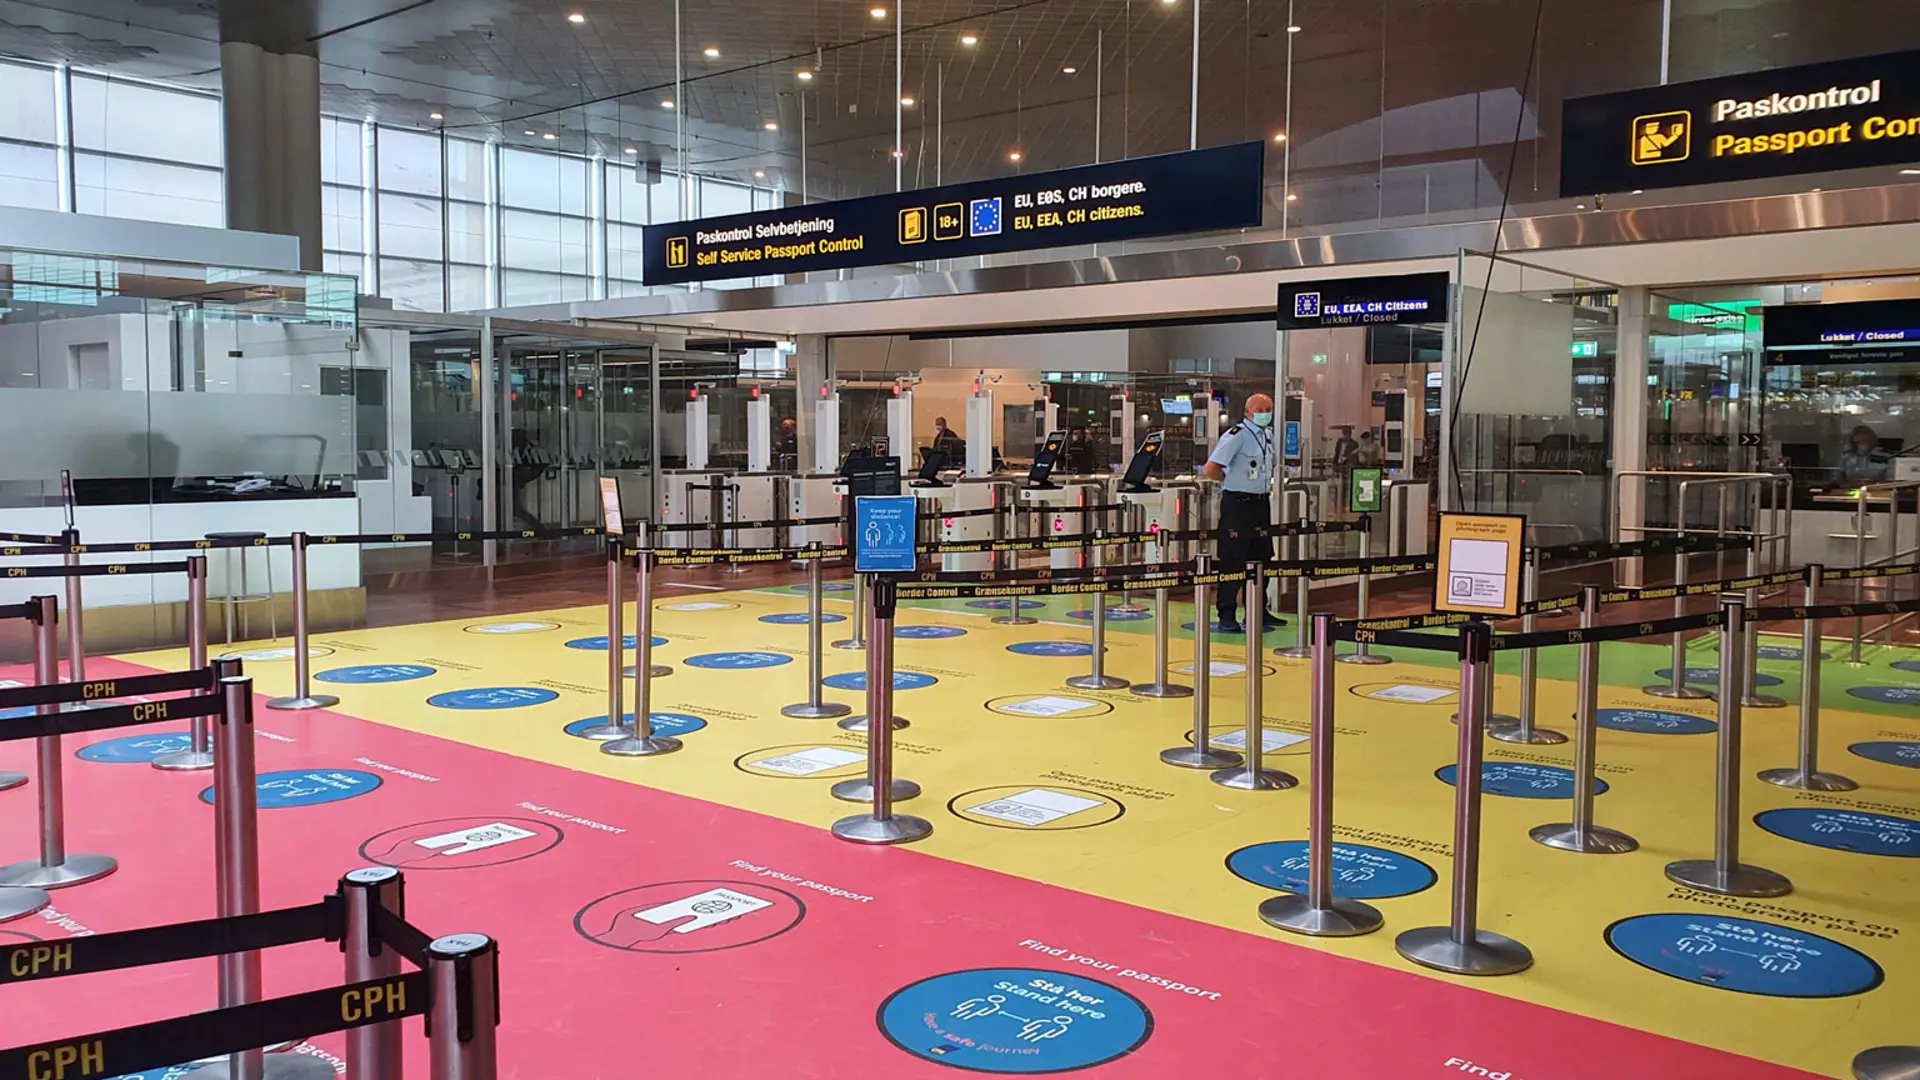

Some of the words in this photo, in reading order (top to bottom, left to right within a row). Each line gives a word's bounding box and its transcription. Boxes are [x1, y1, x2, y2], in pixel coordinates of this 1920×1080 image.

[1713, 79, 1881, 122] Paskontrol
[1714, 122, 1852, 157] Passport
[1014, 194, 1034, 209] EU,
[1037, 189, 1065, 206] EØS,
[1068, 187, 1087, 201] CH
[1091, 180, 1146, 199] borgere.
[939, 215, 959, 229] 18+
[1014, 217, 1034, 230] EU,
[1037, 213, 1064, 229] EEA,
[1067, 208, 1086, 224] CH
[1089, 204, 1144, 222] citizens.
[696, 226, 753, 245] Paskontrol
[756, 218, 835, 238] Selvbetjening
[696, 251, 718, 266] Self
[721, 249, 762, 264] Service
[764, 241, 816, 259] Passport
[818, 235, 863, 254] Control
[1320, 314, 1352, 325] Lukket
[1363, 312, 1398, 323] Closed
[1324, 305, 1341, 315] EU,
[1343, 303, 1365, 313] EEA,
[1367, 302, 1382, 312] CH
[1385, 300, 1428, 311] Citizens
[1820, 333, 1855, 342] Lukket
[1866, 331, 1904, 340] Closed
[1775, 352, 1784, 362] 4
[4, 548, 21, 556] CPH
[70, 545, 87, 553] CPH
[134, 543, 150, 551] CPH
[195, 540, 211, 549] CPH
[254, 538, 269, 546] CPH
[323, 535, 336, 543] CPH
[392, 533, 405, 541] CPH
[458, 532, 471, 540] CPH
[658, 556, 686, 564] Border
[686, 556, 714, 564] Control
[729, 553, 783, 562] Grænsekontrol
[797, 549, 822, 558] Border
[822, 548, 848, 557] Control
[1011, 542, 1032, 550] Control
[8, 568, 27, 577] CPH
[108, 565, 126, 574] CPH
[921, 573, 936, 581] CPH
[980, 572, 995, 580] CPH
[1038, 570, 1052, 578] CPH
[1093, 568, 1107, 576] CPH
[1146, 564, 1160, 573] CPH
[1264, 569, 1278, 577] rder
[1278, 568, 1302, 577] Control
[1314, 566, 1359, 575] Grænsekontrol
[1371, 565, 1391, 573] Border
[1392, 563, 1414, 572] Control
[896, 588, 926, 598] Border
[927, 586, 958, 597] Control
[974, 586, 1036, 596] Grænsekontrol
[1051, 584, 1078, 593] Border
[1079, 583, 1108, 592] Control
[1123, 578, 1179, 590] Grænsekontrol
[1193, 574, 1218, 585] Border
[1219, 571, 1246, 582] Control
[1355, 630, 1376, 642] CPH
[1490, 637, 1505, 649] CPH
[1568, 631, 1582, 642] CPH
[1640, 624, 1653, 634] CPH
[1707, 614, 1719, 625] CPH
[1423, 615, 1446, 626] Border
[83, 682, 116, 699] CPH
[133, 702, 168, 721] CPH
[1039, 774, 1125, 793] photograph
[1124, 790, 1165, 800] page
[1051, 770, 1088, 781] Open
[1089, 778, 1153, 793] passport
[1155, 790, 1175, 798] on
[1371, 830, 1450, 849] passport
[728, 859, 765, 873] Find
[760, 868, 802, 884] your
[799, 880, 874, 904] passport
[714, 891, 758, 907] PASSPORT
[1673, 887, 1737, 903] Open
[1744, 901, 1858, 927] passport
[1865, 921, 1900, 936] on
[1667, 893, 1819, 926] photograph
[1825, 922, 1895, 940] page
[1686, 923, 1760, 944] Stand
[1763, 940, 1823, 957] here
[1716, 922, 1757, 936] Stå
[1761, 930, 1806, 945] her
[10, 943, 72, 977] CPH
[1018, 938, 1068, 957] Find
[1062, 952, 1120, 972] your
[1117, 967, 1223, 1002] passport
[993, 980, 1058, 1005] Stand
[1055, 999, 1106, 1020] here
[1028, 978, 1065, 995] Stå
[1065, 989, 1105, 1006] her
[27, 1039, 105, 1080] CPH
[341, 982, 406, 1022] CPH
[1443, 1056, 1512, 1080] Find
